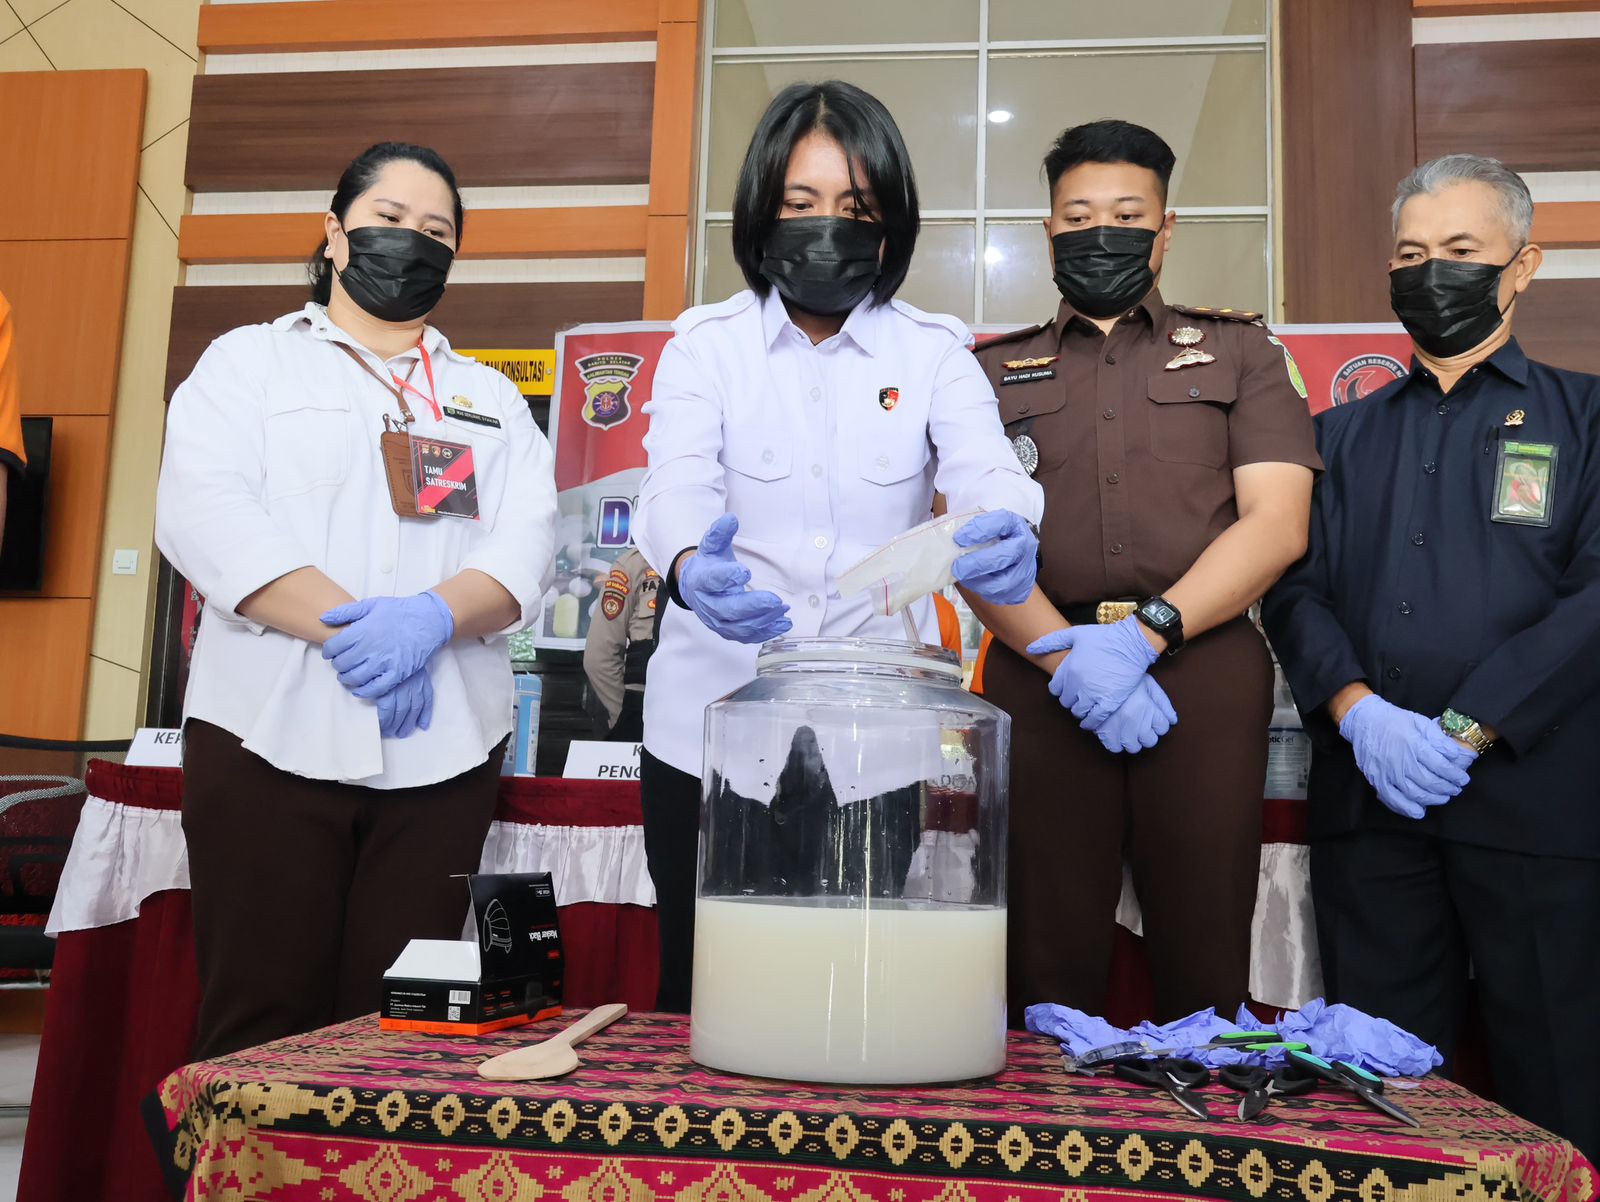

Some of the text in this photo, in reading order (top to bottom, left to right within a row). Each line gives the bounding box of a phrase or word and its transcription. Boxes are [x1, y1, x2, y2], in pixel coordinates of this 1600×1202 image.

[501, 360, 545, 382] KONSULTASI
[1031, 370, 1053, 378] KUSUMA
[1342, 359, 1367, 377] SATUAN
[1367, 358, 1399, 372] RESERSE
[424, 465, 443, 476] TAMU
[425, 476, 467, 491] SATRESKRIM
